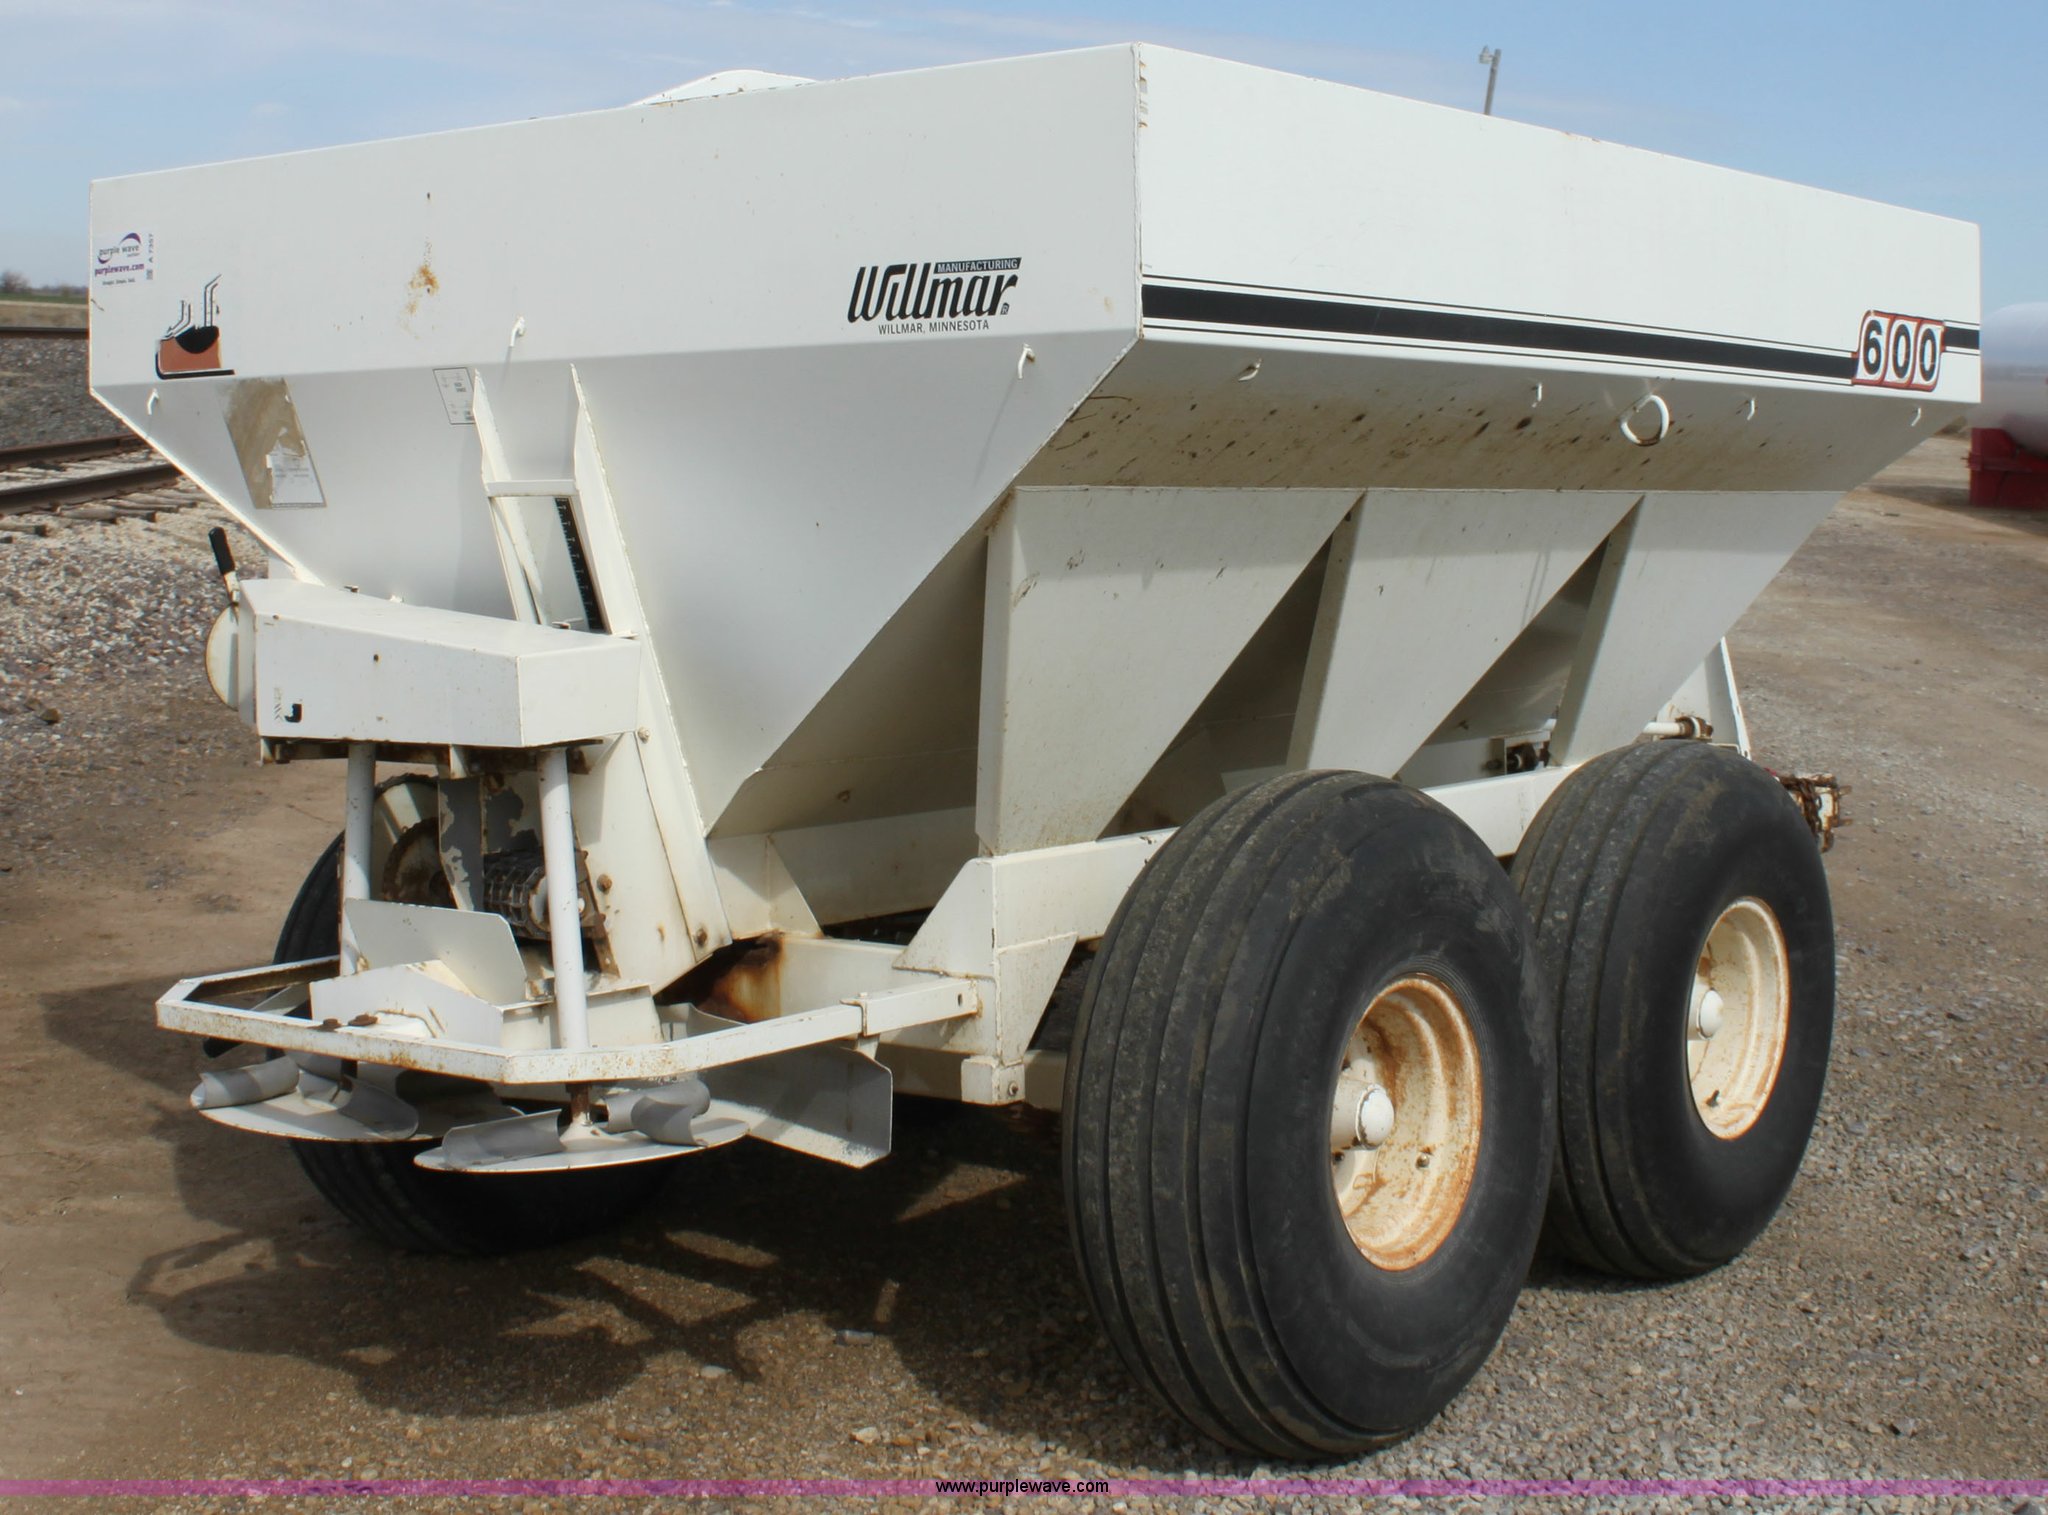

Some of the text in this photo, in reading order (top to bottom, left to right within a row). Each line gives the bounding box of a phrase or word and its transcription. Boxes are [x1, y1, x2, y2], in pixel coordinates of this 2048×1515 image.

[95, 264, 144, 276] purplewave.com
[937, 259, 1018, 273] MANUFACTURING
[847, 262, 1019, 323] Willmar
[878, 319, 990, 335] WILLMAR, MINNESOTA
[1862, 319, 1938, 382] 600
